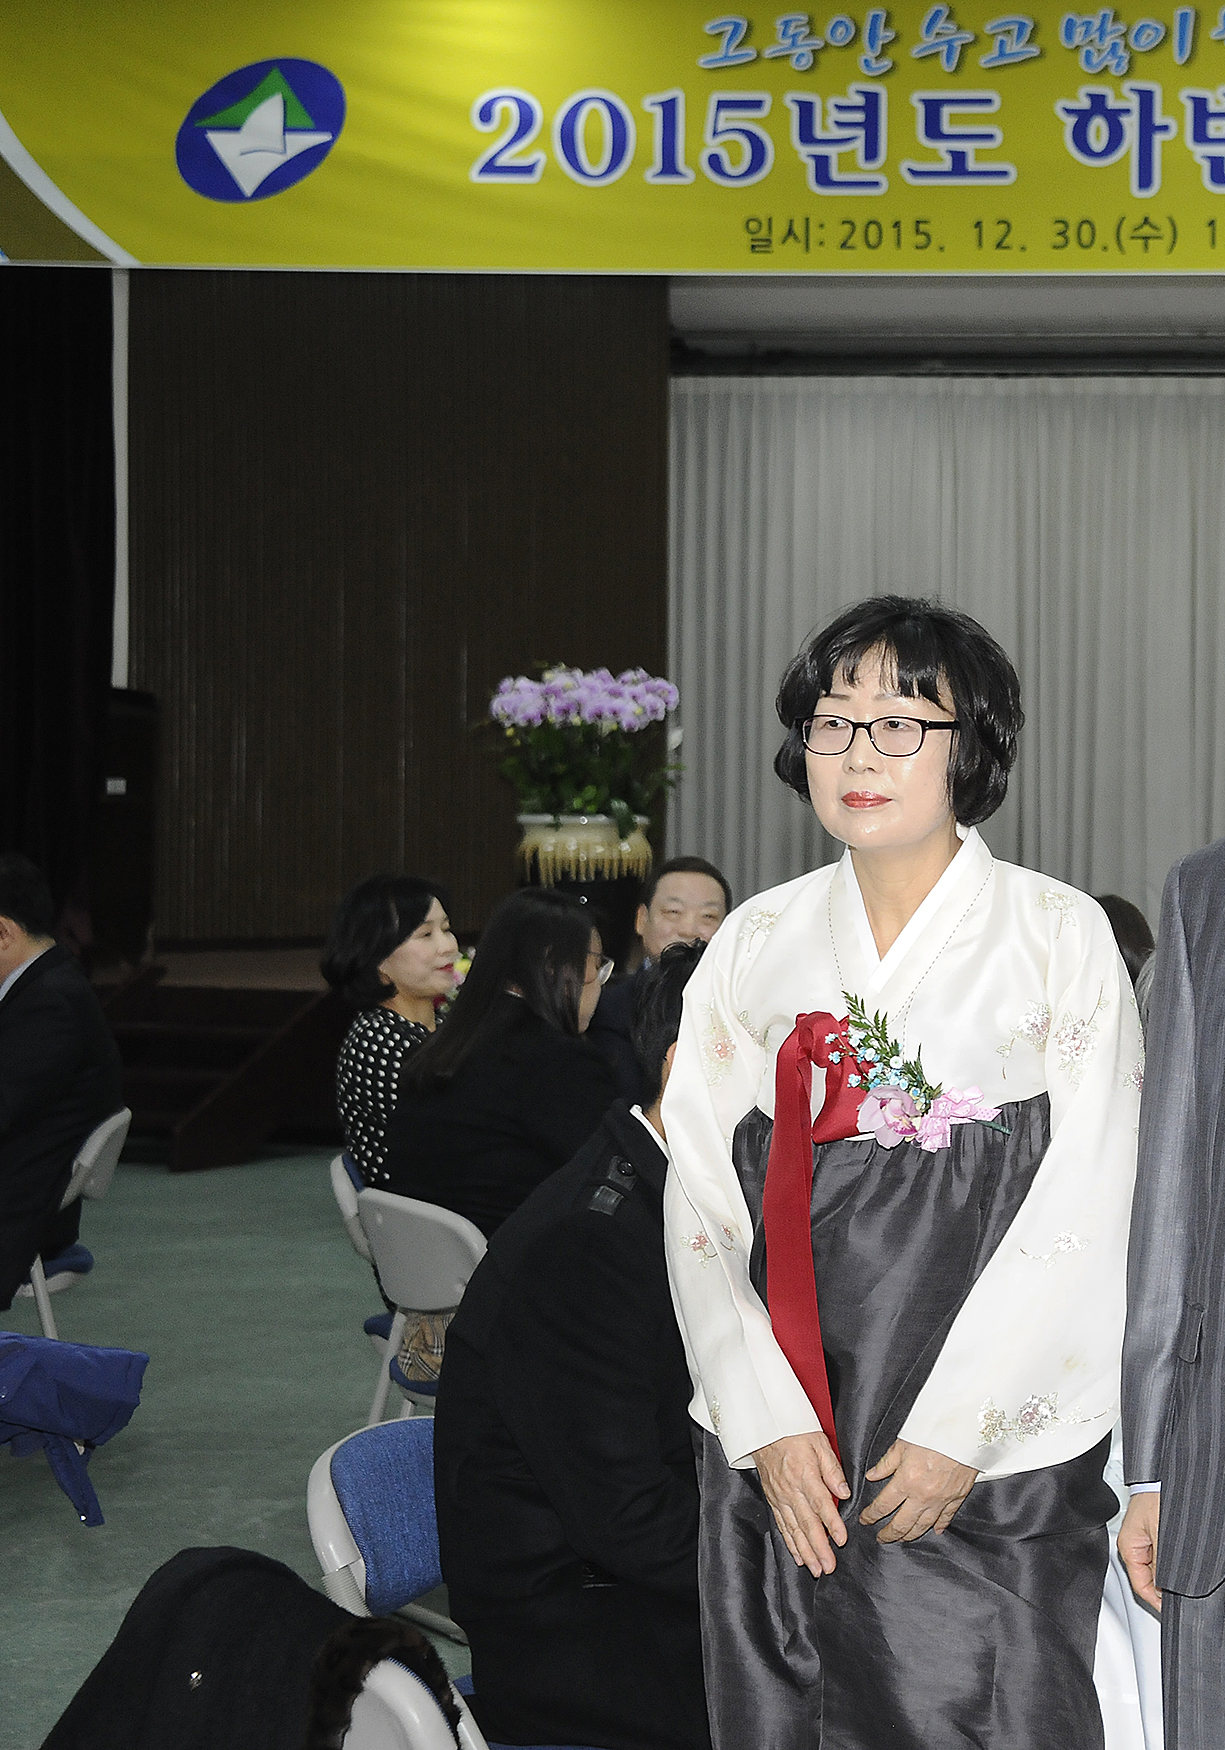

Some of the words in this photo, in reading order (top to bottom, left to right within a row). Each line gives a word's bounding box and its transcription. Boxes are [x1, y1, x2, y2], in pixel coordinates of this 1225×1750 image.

[698, 9, 895, 76] 그동안
[911, 4, 1041, 73] 수고
[1059, 6, 1196, 76] 많이
[471, 83, 1017, 197] 2015년도
[744, 217, 826, 254] 일시:
[839, 219, 946, 253] 2015.
[973, 220, 1028, 252] 12.
[1051, 215, 1179, 255] 30.(수)
